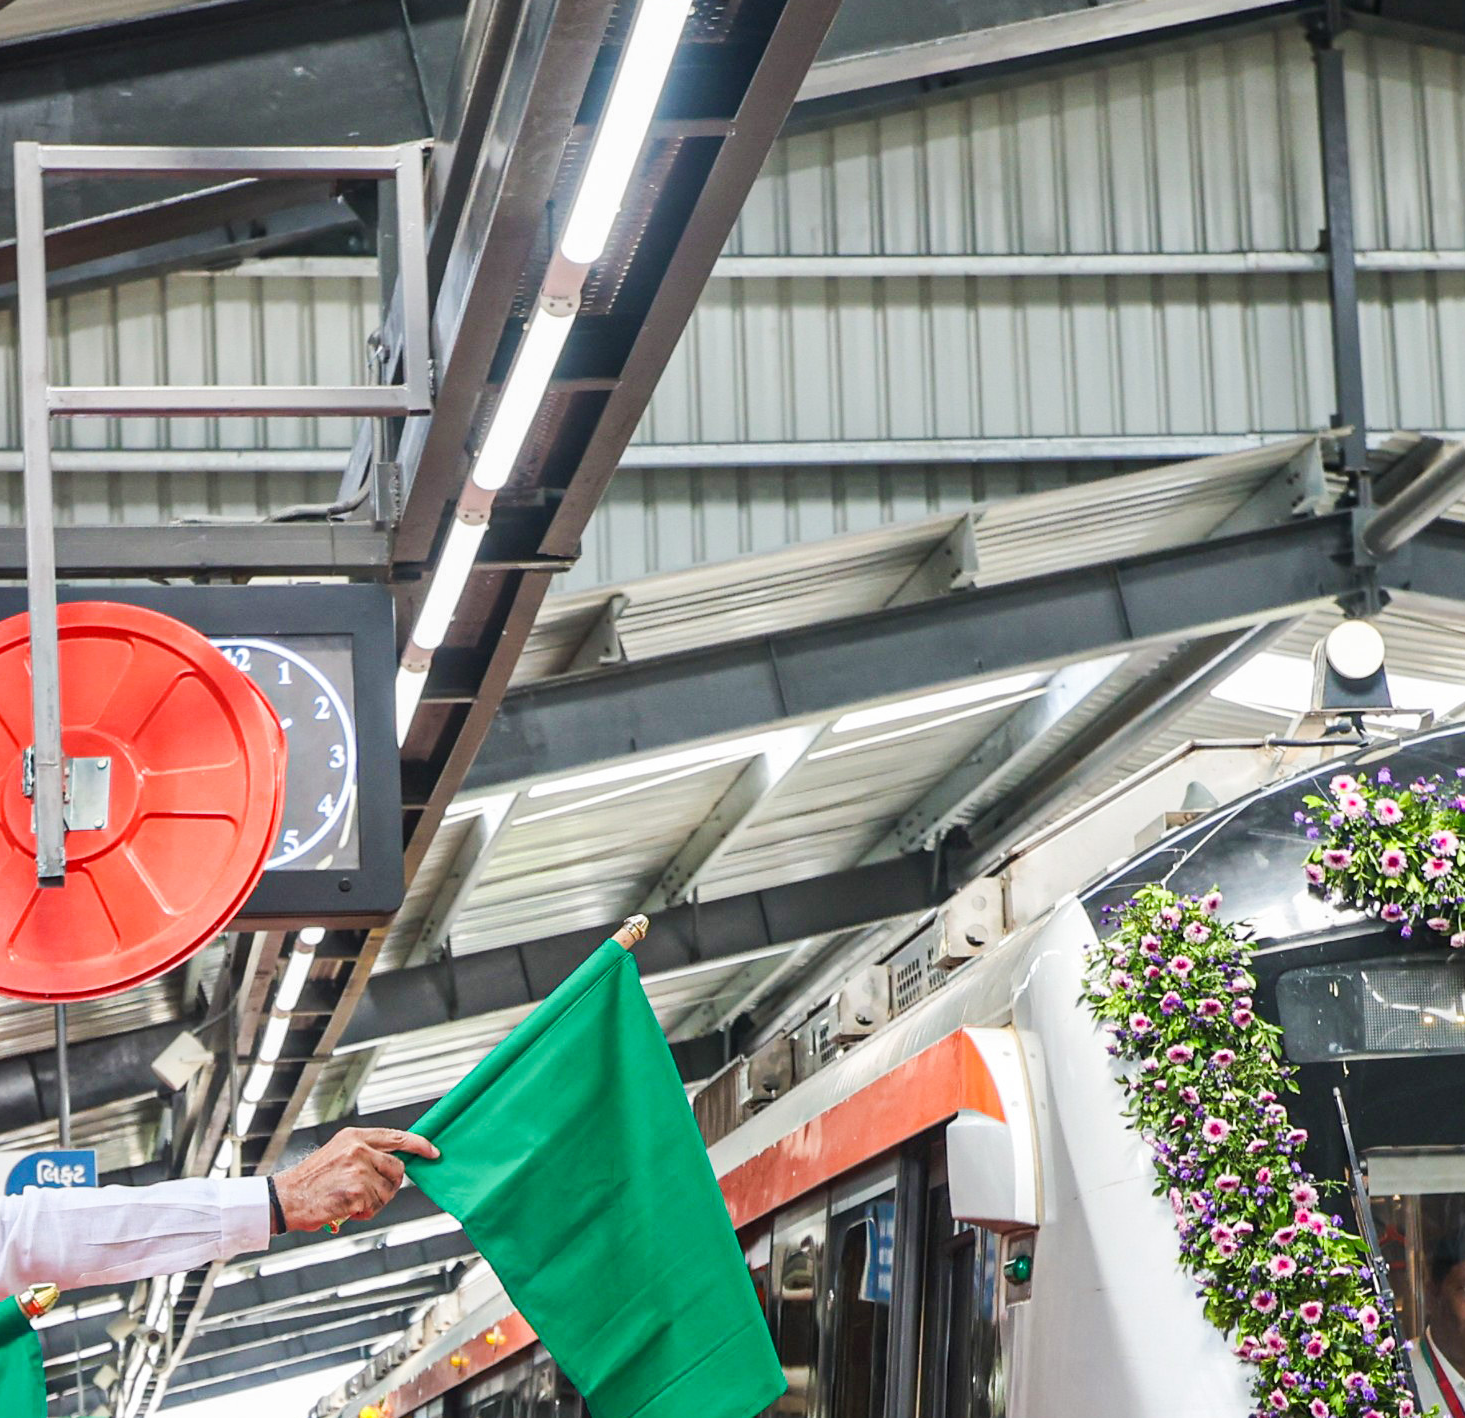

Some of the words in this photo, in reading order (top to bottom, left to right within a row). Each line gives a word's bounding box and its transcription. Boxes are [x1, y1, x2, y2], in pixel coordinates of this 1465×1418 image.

[222, 648, 252, 671] 12
[278, 661, 292, 684] 1
[314, 696, 330, 719] 2
[329, 744, 345, 768] 3
[317, 793, 334, 817] 4
[283, 830, 299, 853] 5
